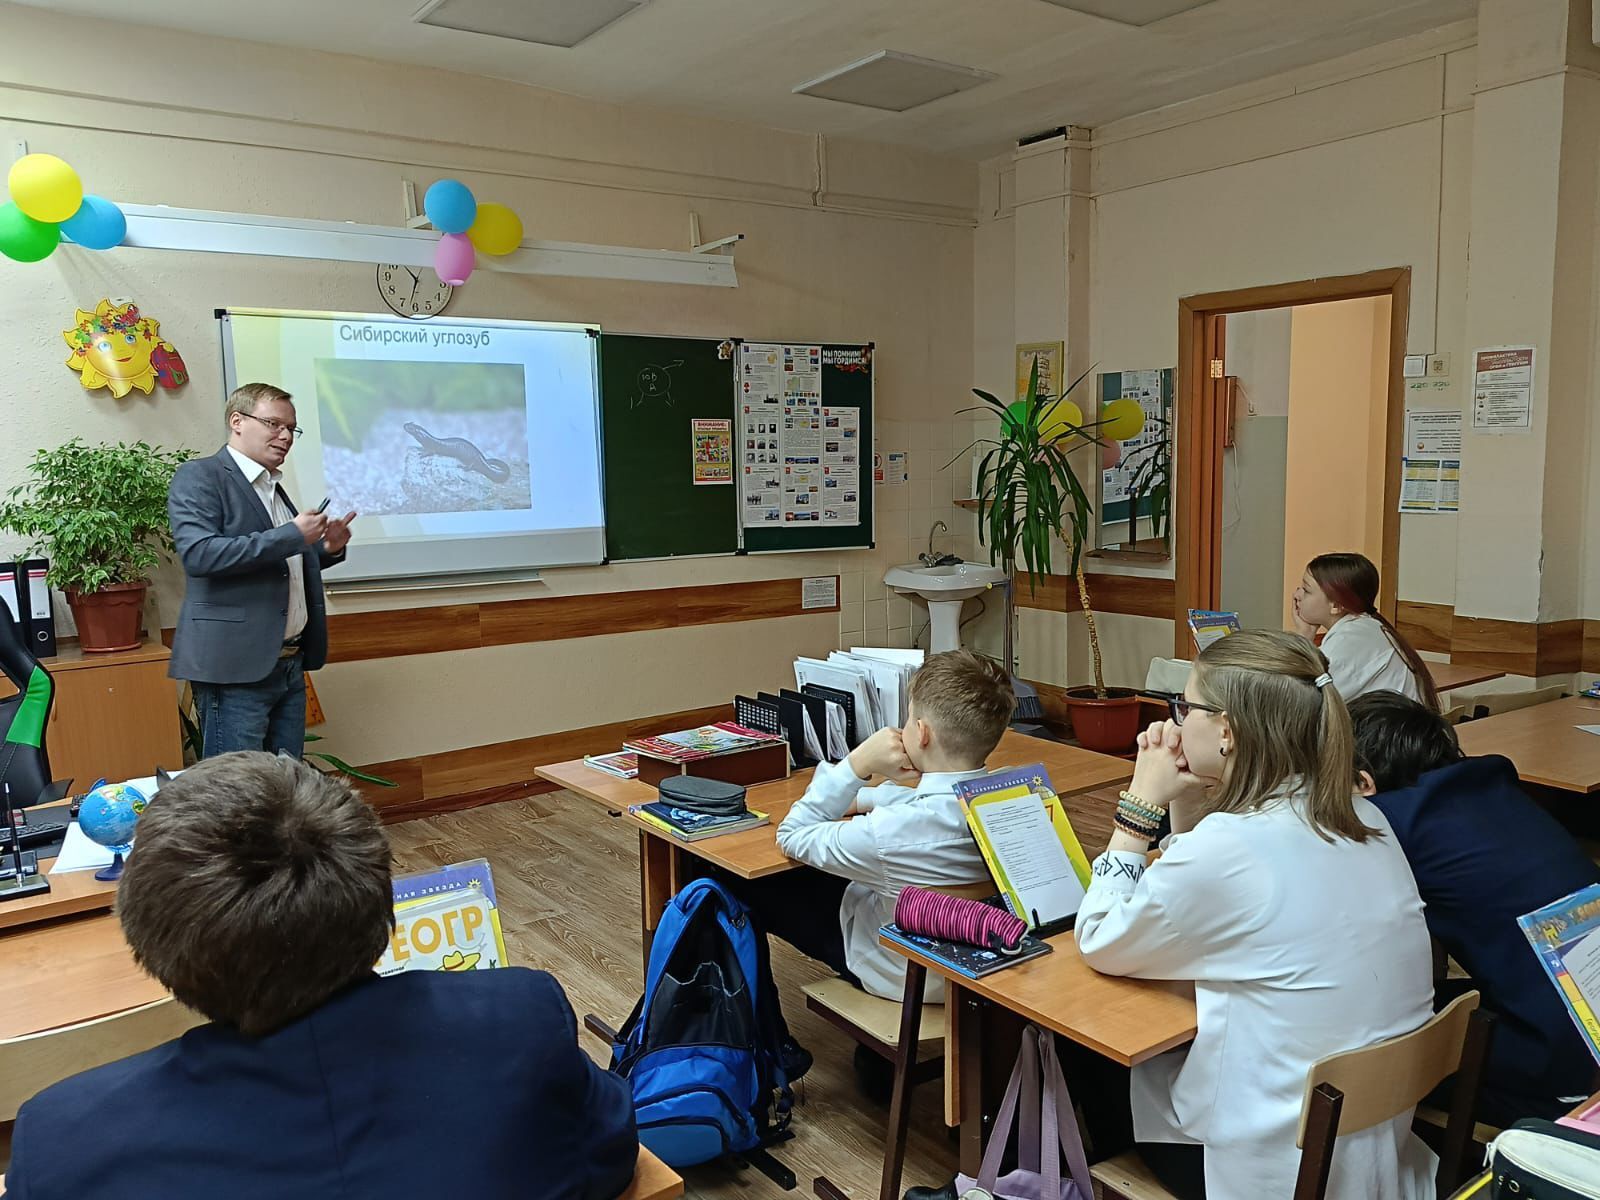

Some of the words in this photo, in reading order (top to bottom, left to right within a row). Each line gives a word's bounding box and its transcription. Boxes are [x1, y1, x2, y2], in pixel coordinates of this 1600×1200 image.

[384, 271, 392, 282] 9
[388, 284, 396, 295] 8
[399, 297, 406, 307] 7
[434, 292, 441, 302] 4
[412, 302, 419, 313] 6
[424, 300, 432, 311] 5
[339, 324, 428, 346] Сибирский
[432, 330, 490, 349] углозуб
[395, 891, 416, 900] НАЯ
[421, 881, 462, 895] ЗВЕЗДА
[379, 905, 484, 964] ЕОГР
